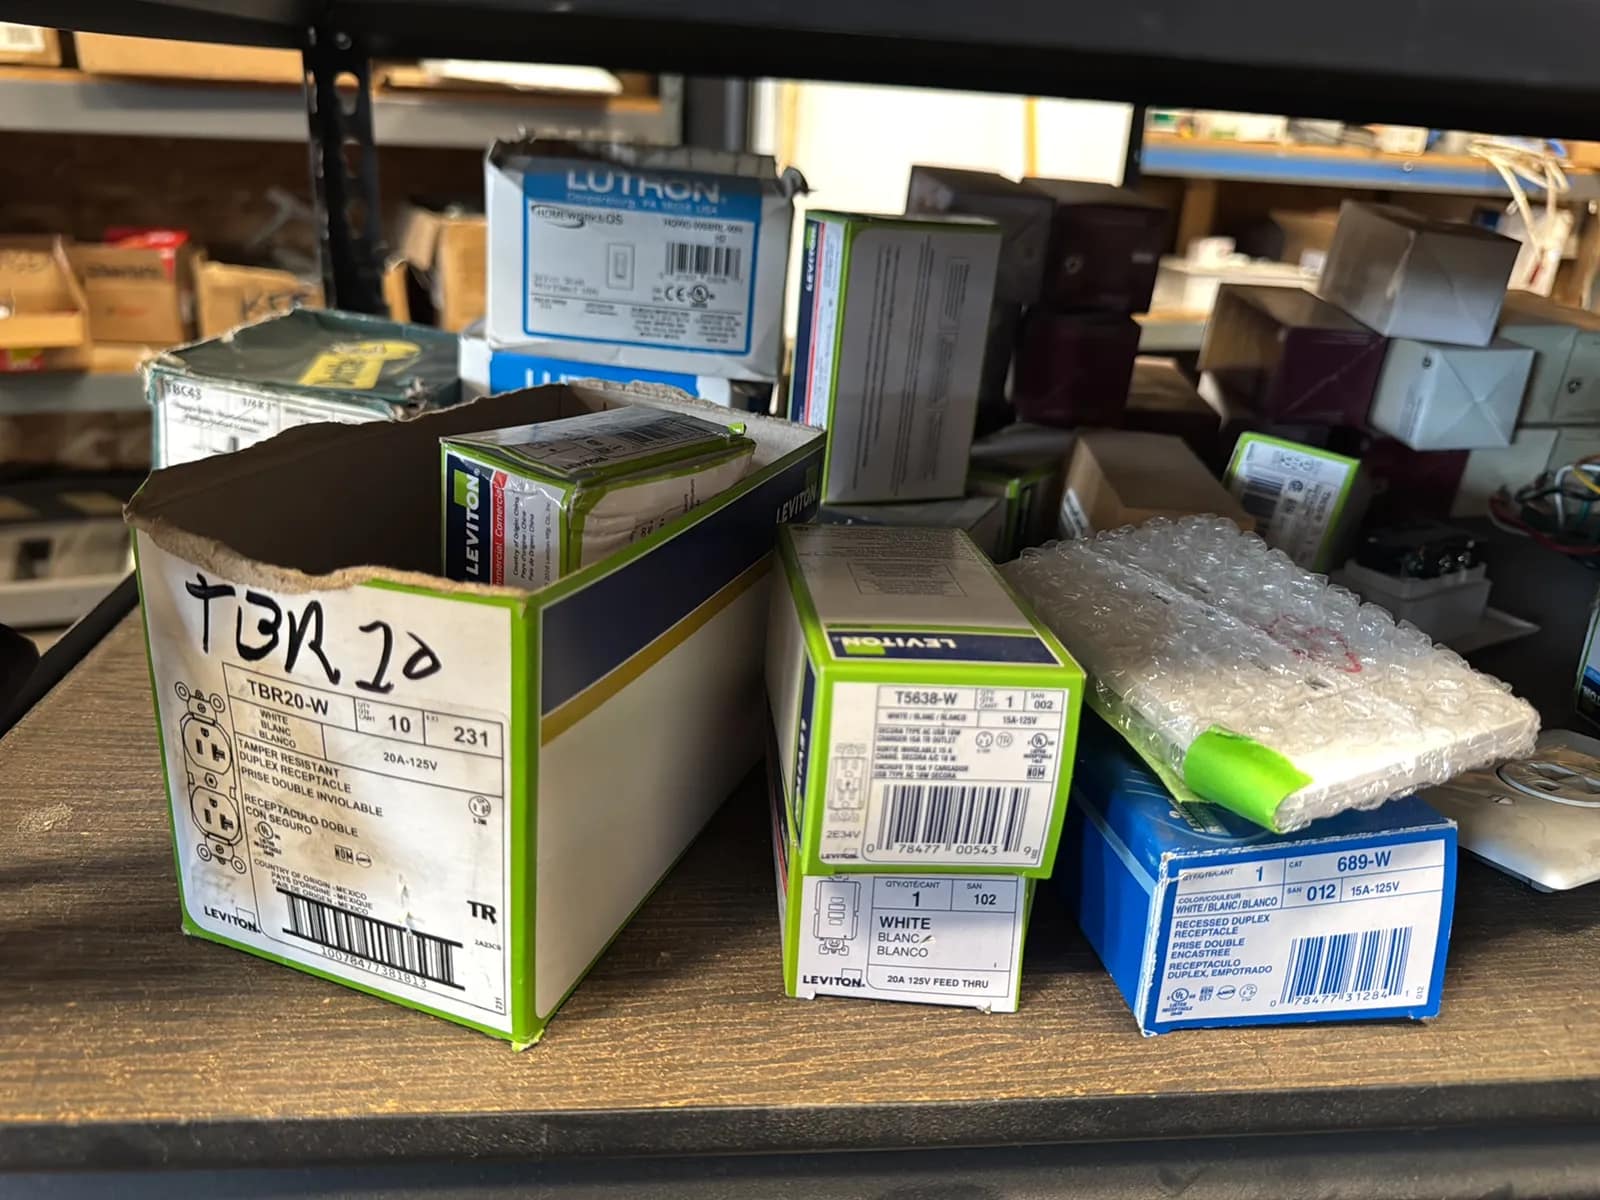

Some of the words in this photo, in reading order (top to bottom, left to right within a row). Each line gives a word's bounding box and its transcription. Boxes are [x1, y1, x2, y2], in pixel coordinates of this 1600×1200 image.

[566, 167, 720, 204] LUTRON
[495, 484, 505, 538] Comercial
[466, 472, 480, 576] LEVITON
[185, 572, 341, 685] TBR
[841, 635, 958, 650] LEVITON
[895, 690, 958, 706] T5638-W
[1006, 695, 1013, 709] 1
[1034, 700, 1054, 710] 002
[247, 679, 330, 716] TBR20-W
[387, 714, 412, 734] 10
[453, 725, 489, 748] 231
[260, 709, 289, 725] WHITE
[260, 719, 292, 737] BLANC
[258, 731, 297, 749] BLANCO
[238, 737, 279, 760] TAMPER
[280, 751, 340, 777] RESISTANT
[383, 751, 438, 771] 20A-125V
[239, 751, 279, 772] DUPLEX
[280, 765, 352, 794] RECEPTACLE
[241, 766, 271, 784] PRISE
[272, 776, 313, 798] DOUBLE
[316, 789, 384, 817] INVIOLABLE
[244, 793, 319, 825] RECEPTACULO
[320, 816, 359, 838] DOBLE
[245, 805, 267, 821] CON
[268, 814, 312, 836] SEGURO
[898, 843, 940, 855] 78477
[956, 844, 998, 856] 00543
[1255, 866, 1264, 882] 1
[1288, 860, 1302, 868] CAT
[1337, 851, 1392, 873] 689-W
[254, 859, 289, 876] COUNTRY
[290, 870, 301, 879] OF
[303, 875, 331, 889] ORIGIN
[336, 885, 368, 901] MEXICO
[966, 882, 983, 890] SAN
[271, 871, 291, 884] PAYS
[336, 893, 374, 910] MEXIQUE
[911, 891, 921, 907] 1
[973, 893, 997, 906] 102
[1178, 892, 1242, 904] COLOR/COULEUR
[1306, 884, 1336, 901] 012
[1350, 880, 1400, 897] 15A-125V
[203, 904, 259, 933] LEVITON
[466, 899, 498, 925] TR
[1175, 918, 1230, 929] RECESSED
[1231, 913, 1270, 926] DUPLEX
[879, 915, 931, 930] WHITE
[877, 931, 921, 943] BLANC
[1173, 926, 1239, 939] RECEPTACLE
[876, 945, 929, 958] BLANCO
[1172, 939, 1202, 950] PRISE
[1203, 937, 1245, 949] DOUBLE
[1170, 947, 1231, 960] ENCASTREE
[1166, 969, 1209, 980] DUPLEX,
[1210, 964, 1273, 977] EMPOTRADO
[1168, 958, 1241, 971] RECEPTACULO
[802, 974, 862, 988] LEVITON
[887, 974, 905, 984] 20A
[908, 975, 931, 985] 125V
[933, 976, 960, 987] FEED
[962, 977, 989, 989] THRU
[1269, 999, 1277, 1008] 0
[1294, 993, 1339, 1006] 78477
[1345, 990, 1388, 1002] 31284
